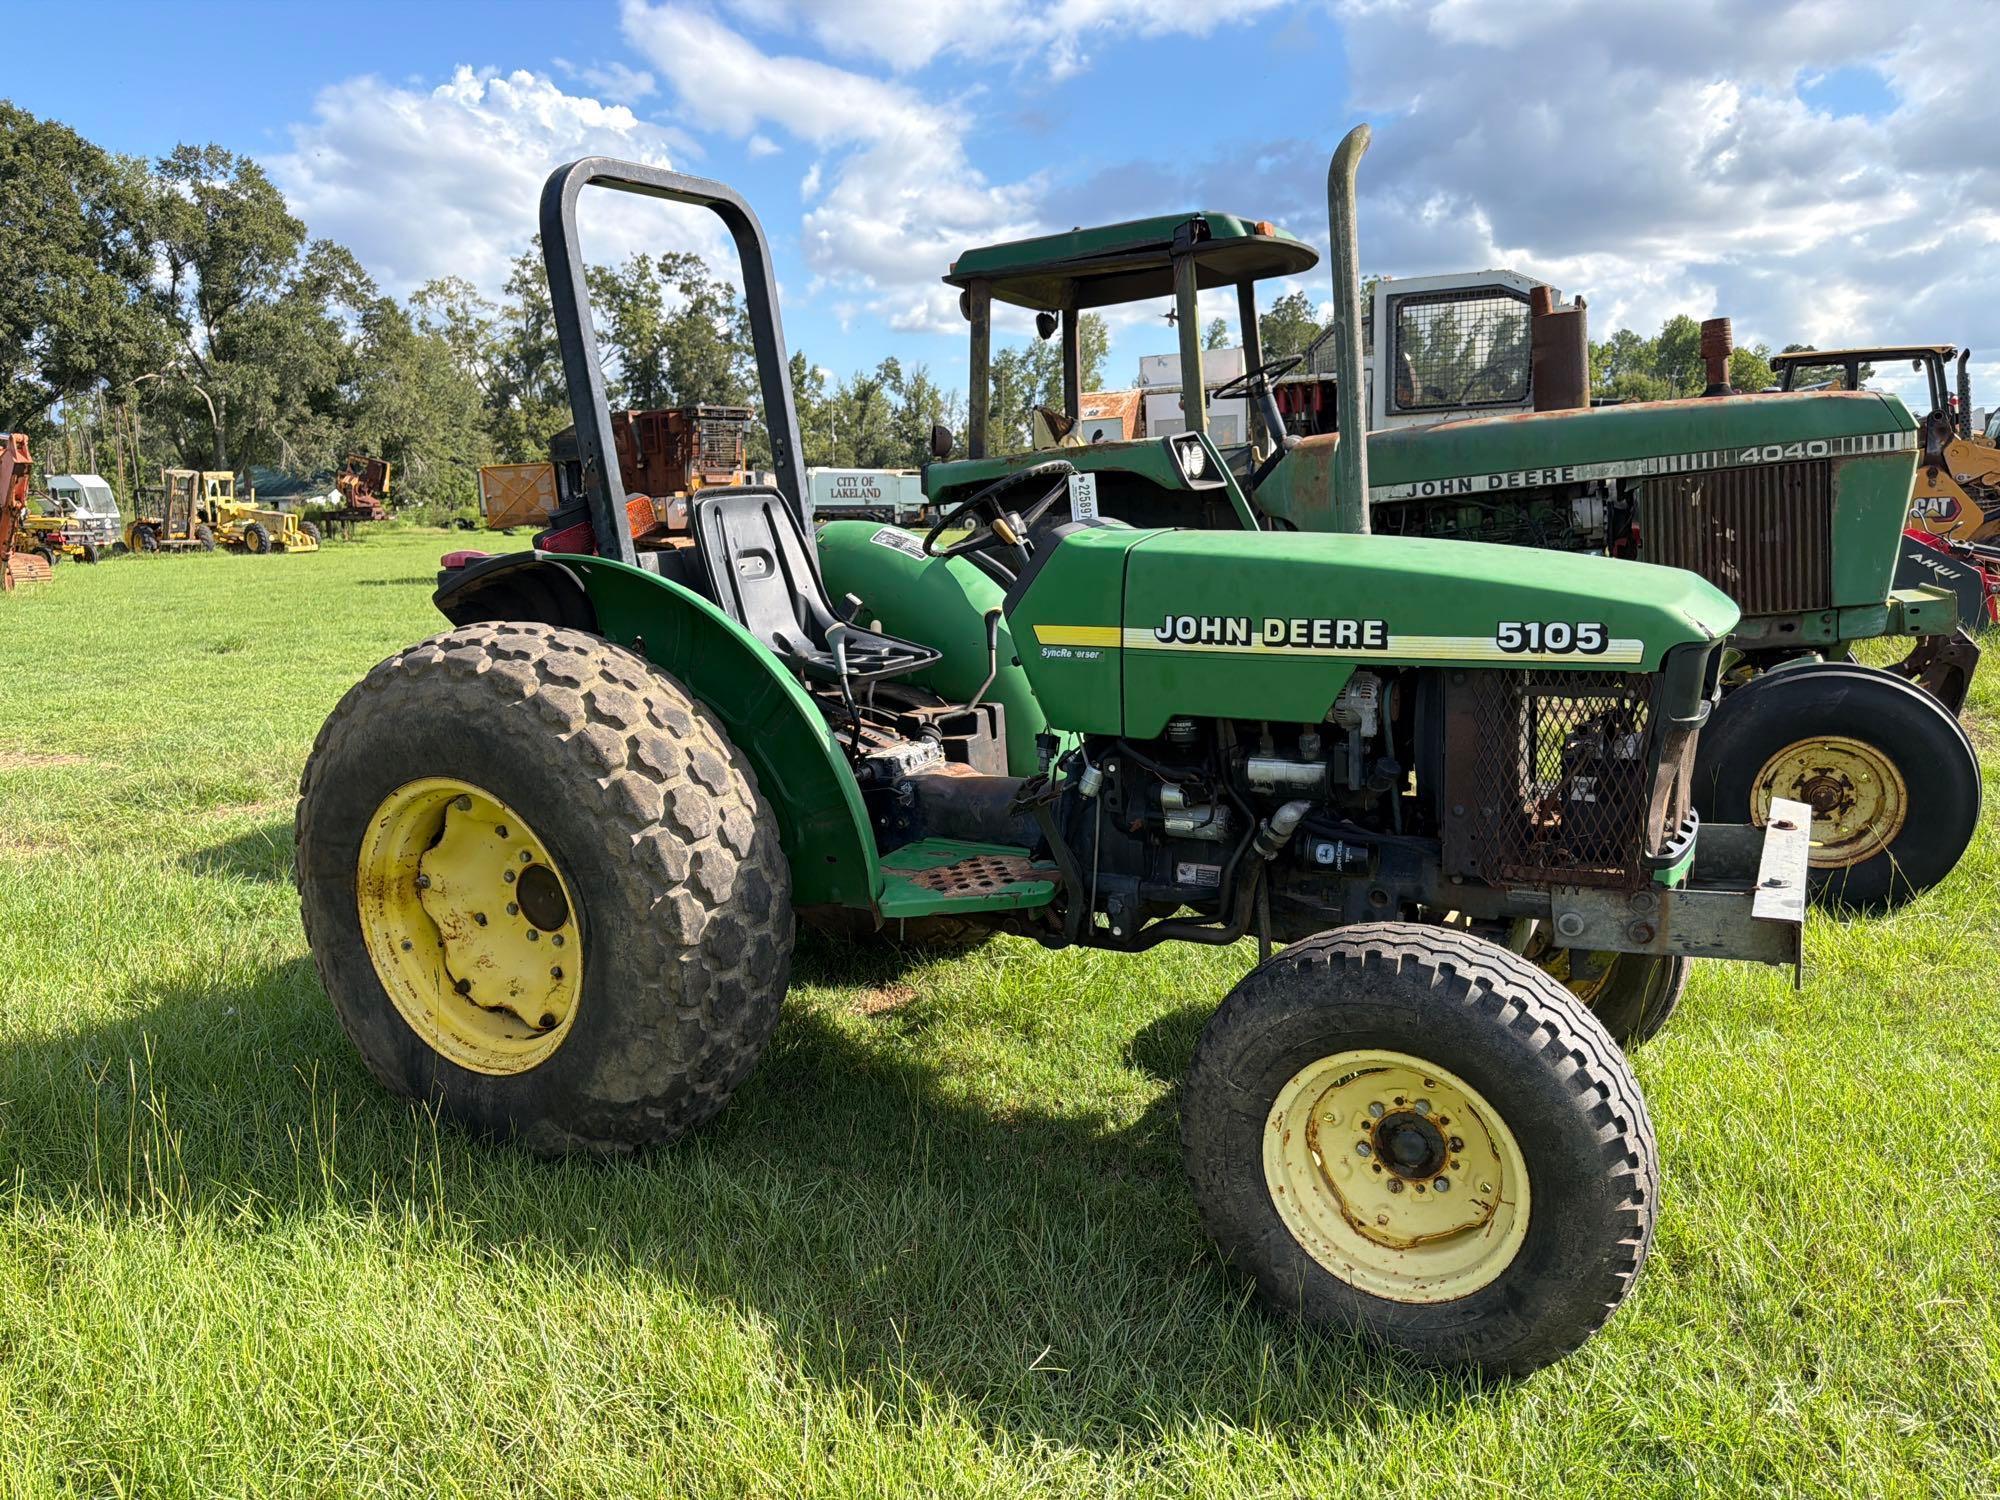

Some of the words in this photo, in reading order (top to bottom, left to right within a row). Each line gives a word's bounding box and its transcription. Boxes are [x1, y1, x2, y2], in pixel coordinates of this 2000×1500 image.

[1739, 439, 1829, 464] 4040
[830, 488, 881, 498] LAKELAND
[836, 476, 859, 487] CITY
[861, 476, 876, 487] OF
[1406, 478, 1474, 498] JOHN
[1488, 467, 1575, 489] DEERE
[1078, 484, 1093, 520] 225897
[1913, 497, 1951, 518] CAT
[1154, 614, 1253, 647] JOHN
[1262, 617, 1388, 651] DEERE
[1496, 620, 1610, 654] 5105
[1041, 647, 1100, 660] SyncReerser
